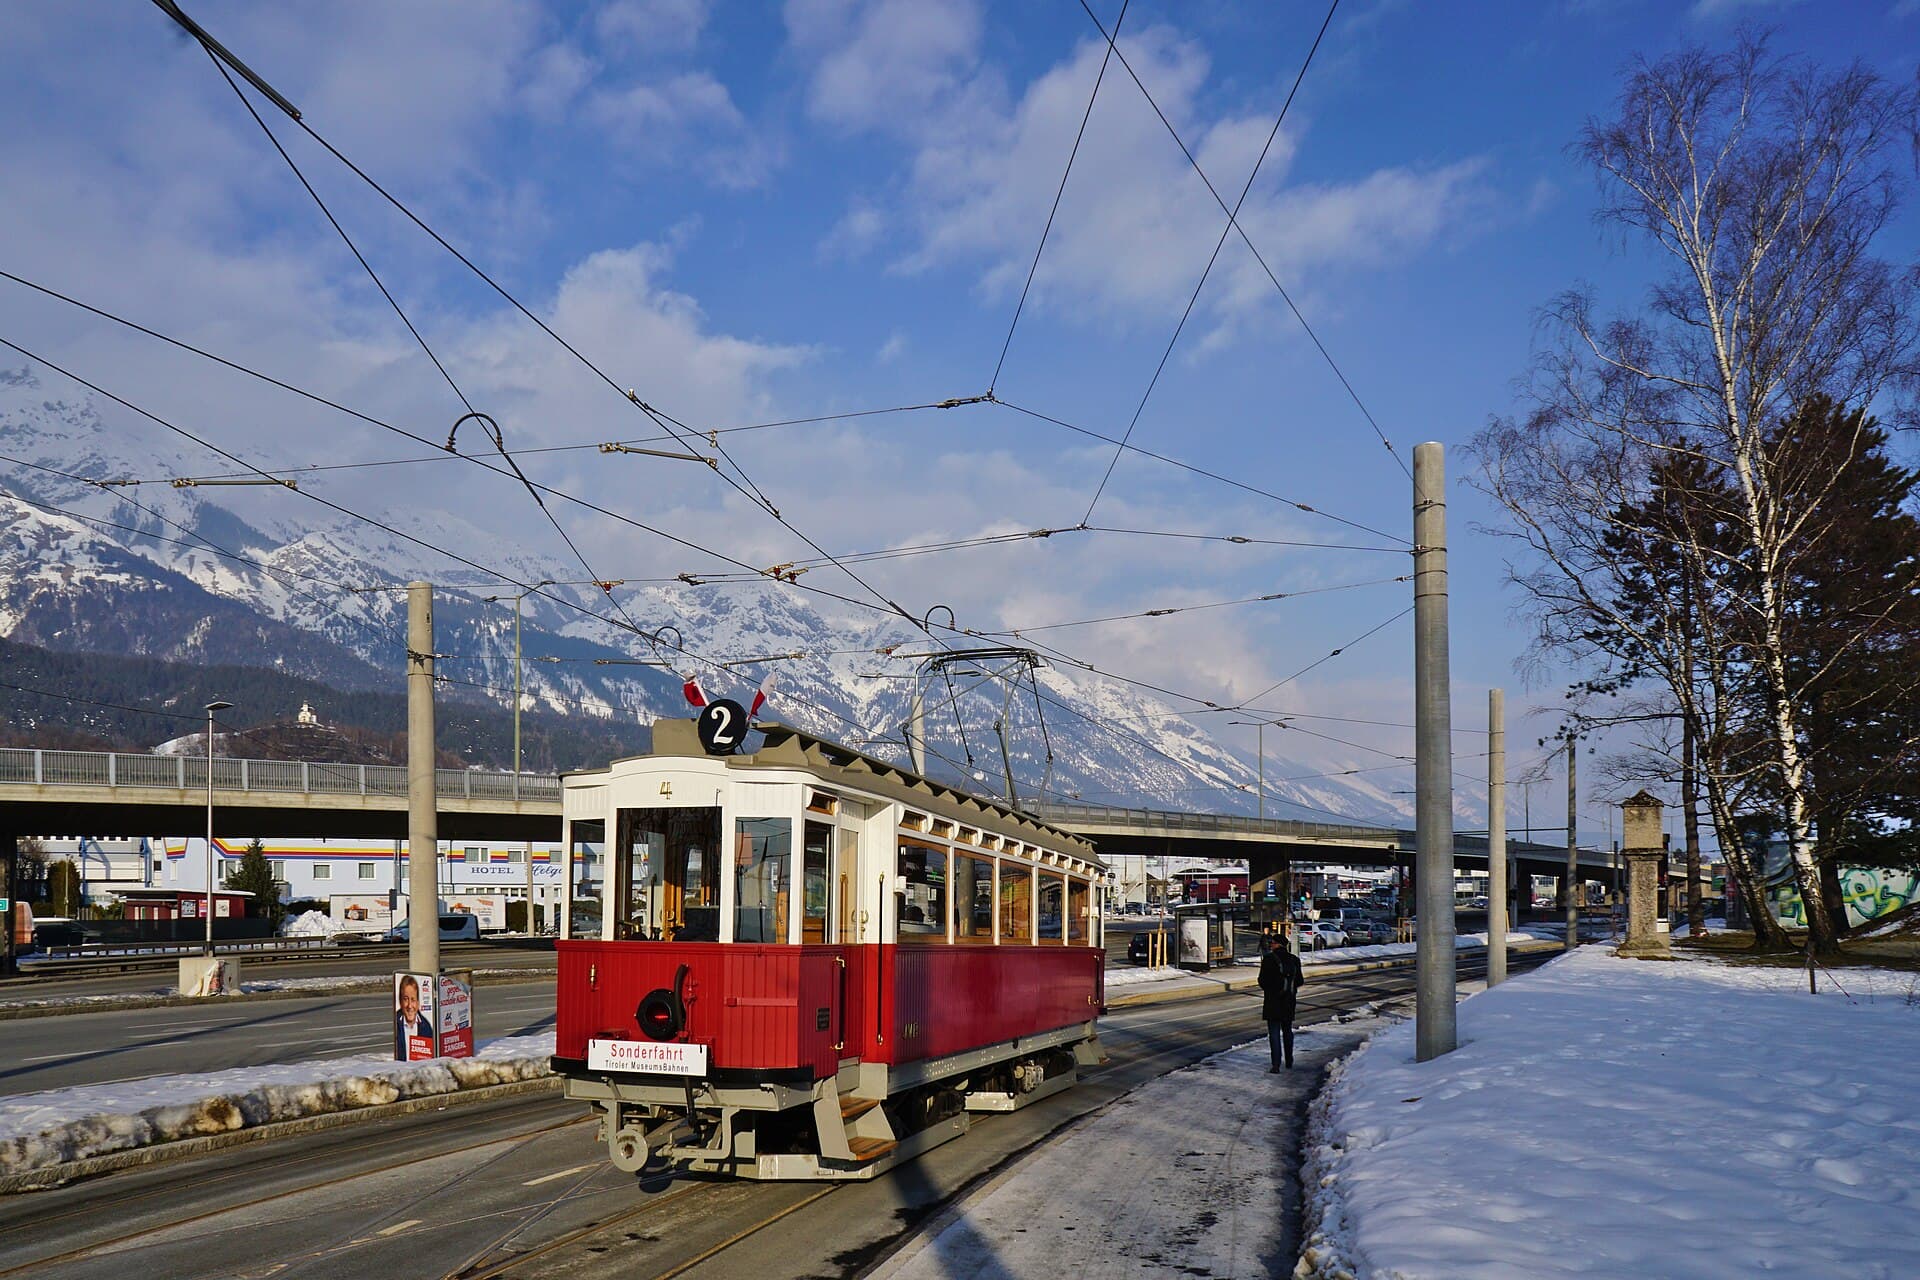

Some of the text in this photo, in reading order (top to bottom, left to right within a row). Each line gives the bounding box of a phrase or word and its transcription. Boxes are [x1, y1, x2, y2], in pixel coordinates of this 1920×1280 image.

[711, 706, 734, 744] 2
[659, 781, 673, 800] 4
[471, 866, 514, 874] HOTEL
[1268, 880, 1274, 888] P
[611, 1043, 683, 1061] Sonderfahrt
[605, 1060, 689, 1073] Tiroler MuseumsBahnen
